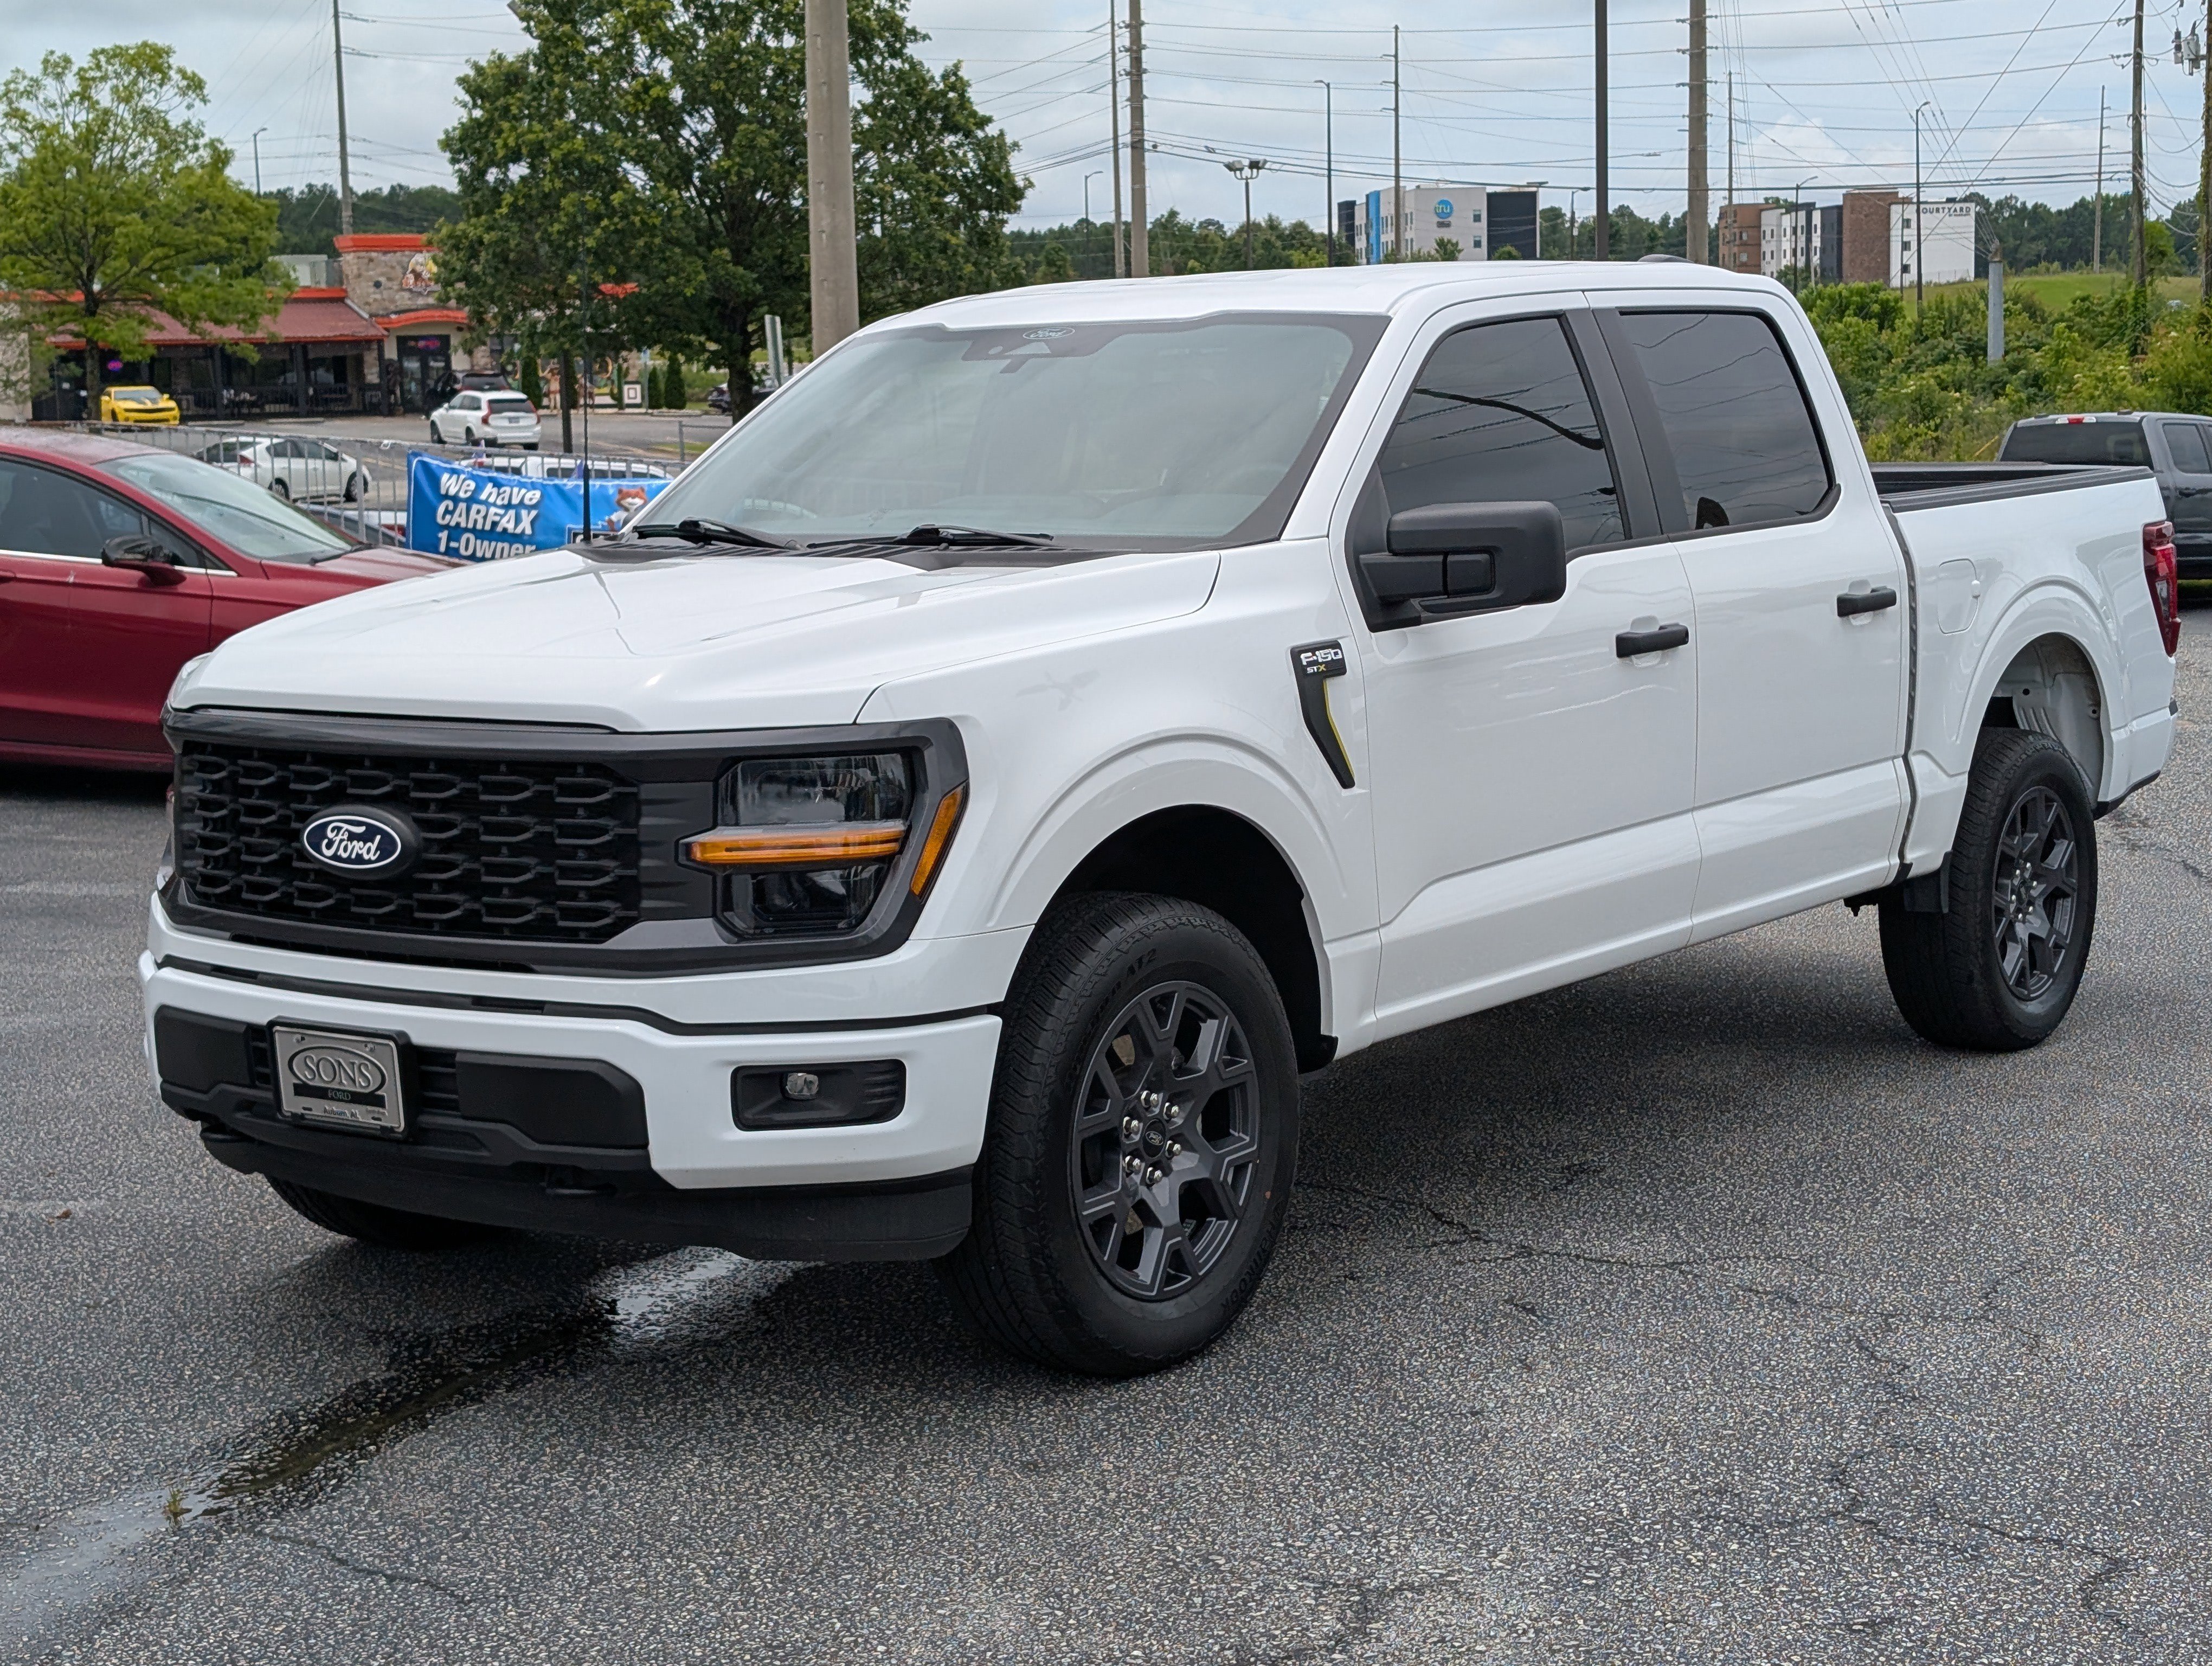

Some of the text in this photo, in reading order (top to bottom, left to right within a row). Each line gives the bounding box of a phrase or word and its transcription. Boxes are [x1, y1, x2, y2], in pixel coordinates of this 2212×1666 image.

[1030, 328, 1066, 338] Ford
[440, 472, 541, 505] We have
[436, 499, 538, 535] CARFAX
[1301, 649, 1342, 665] F-150
[1307, 664, 1327, 674] STX
[322, 822, 381, 861] Ford
[304, 1054, 373, 1089] SONS
[328, 1089, 351, 1100] FORD
